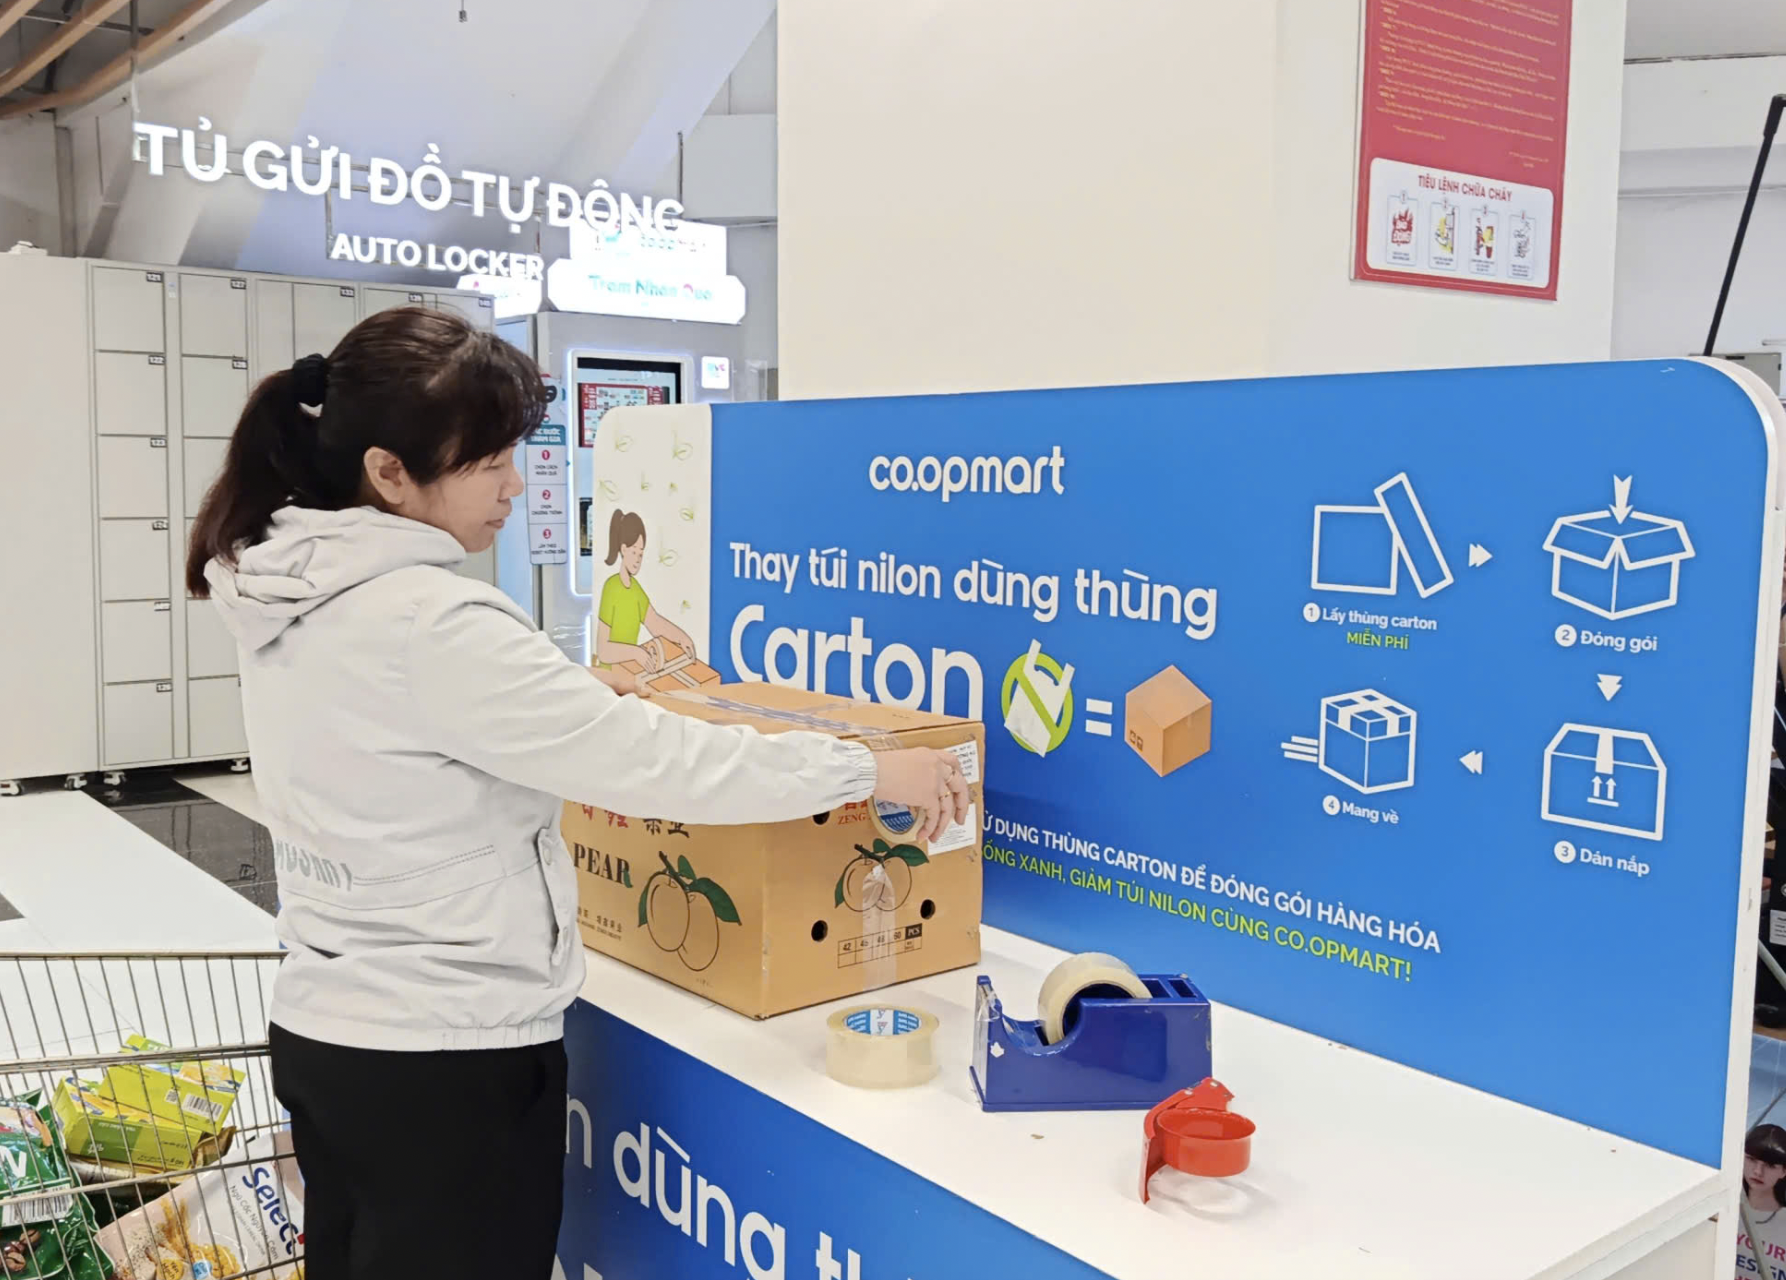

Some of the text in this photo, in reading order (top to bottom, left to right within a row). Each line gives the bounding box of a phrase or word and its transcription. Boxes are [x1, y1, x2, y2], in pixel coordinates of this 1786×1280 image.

[133, 116, 228, 182] TỦ
[242, 135, 352, 200] GỬI
[368, 143, 452, 214] ĐỒ
[462, 170, 541, 234] TỰ
[331, 233, 545, 281] AUTO LOCKER
[869, 446, 1065, 503] co.opmart
[730, 542, 1218, 641] Thay túi nilon dùng thùng
[1322, 607, 1346, 625] Lấy
[1348, 610, 1389, 629] thùng
[1390, 616, 1437, 630] carton
[1346, 627, 1409, 650] MIỄN PHÍ
[1580, 630, 1626, 652] Đóng
[1629, 636, 1658, 653] gói
[730, 604, 984, 720] Carton
[1342, 801, 1380, 823] Mang
[1382, 809, 1400, 824] về
[573, 842, 633, 888] PEAR
[995, 818, 1039, 845] DỤNG
[1042, 830, 1100, 861] THÙNG
[1103, 847, 1177, 882] CARTON
[1181, 864, 1207, 890] ĐỂ
[1210, 874, 1270, 907] ĐÓNG
[1274, 891, 1312, 918] GÓI
[1317, 901, 1383, 938] HÀNG
[1388, 920, 1441, 953] HÓA
[1580, 848, 1613, 868] Dán
[1616, 855, 1650, 877] nắp
[908, 928, 920, 936] PCS
[983, 839, 1016, 867] ỐNG
[1019, 853, 1067, 884] XANH,
[1116, 880, 1144, 905] TÚI
[1149, 890, 1206, 923] NILON
[1211, 907, 1269, 940] CÙNG
[1273, 926, 1412, 982] CO.OPMART!
